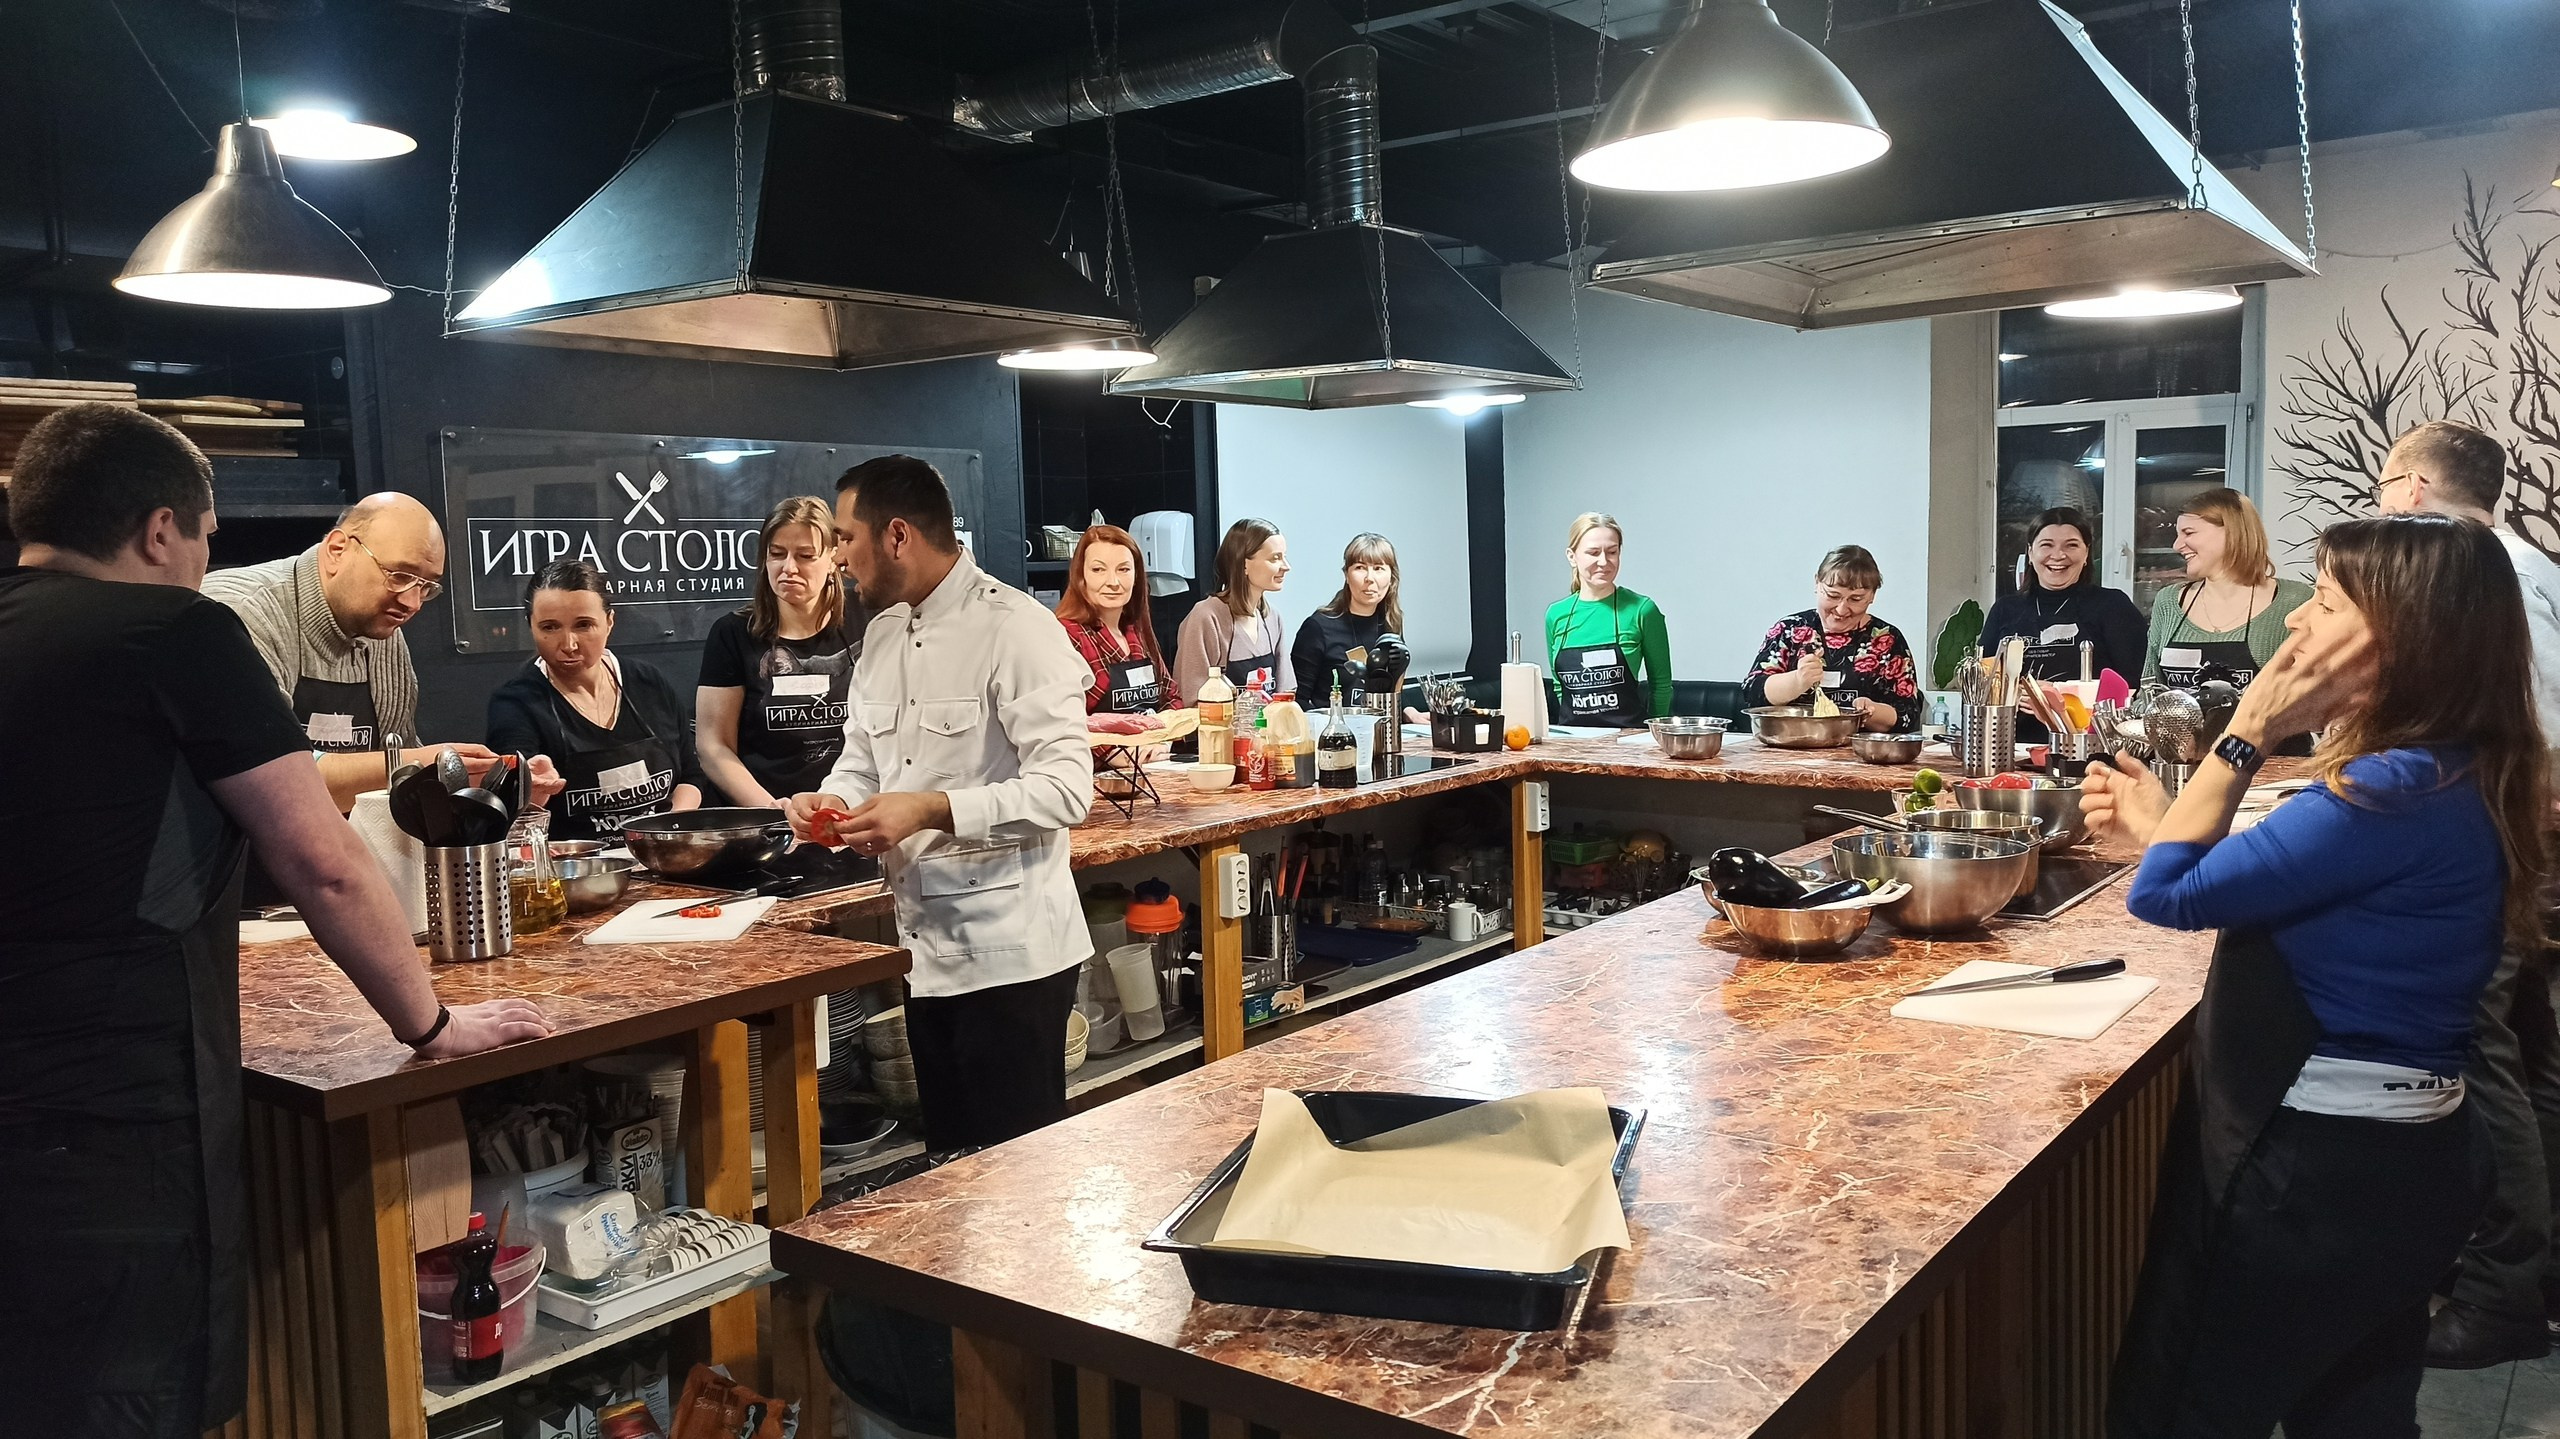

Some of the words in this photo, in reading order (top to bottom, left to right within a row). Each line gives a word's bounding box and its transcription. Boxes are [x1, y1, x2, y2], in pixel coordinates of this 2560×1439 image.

[479, 529, 608, 576] ИГРА
[616, 529, 761, 573] СТОЛО
[676, 577, 745, 593] СТУДИЯ
[1580, 668, 1622, 682] СТОЛОВ
[1115, 690, 1140, 703] ИГРА
[770, 708, 808, 721] ИГРА
[571, 789, 615, 807] ИГРА
[617, 773, 671, 801] СТОЛОВ
[639, 1149, 662, 1170] 33%
